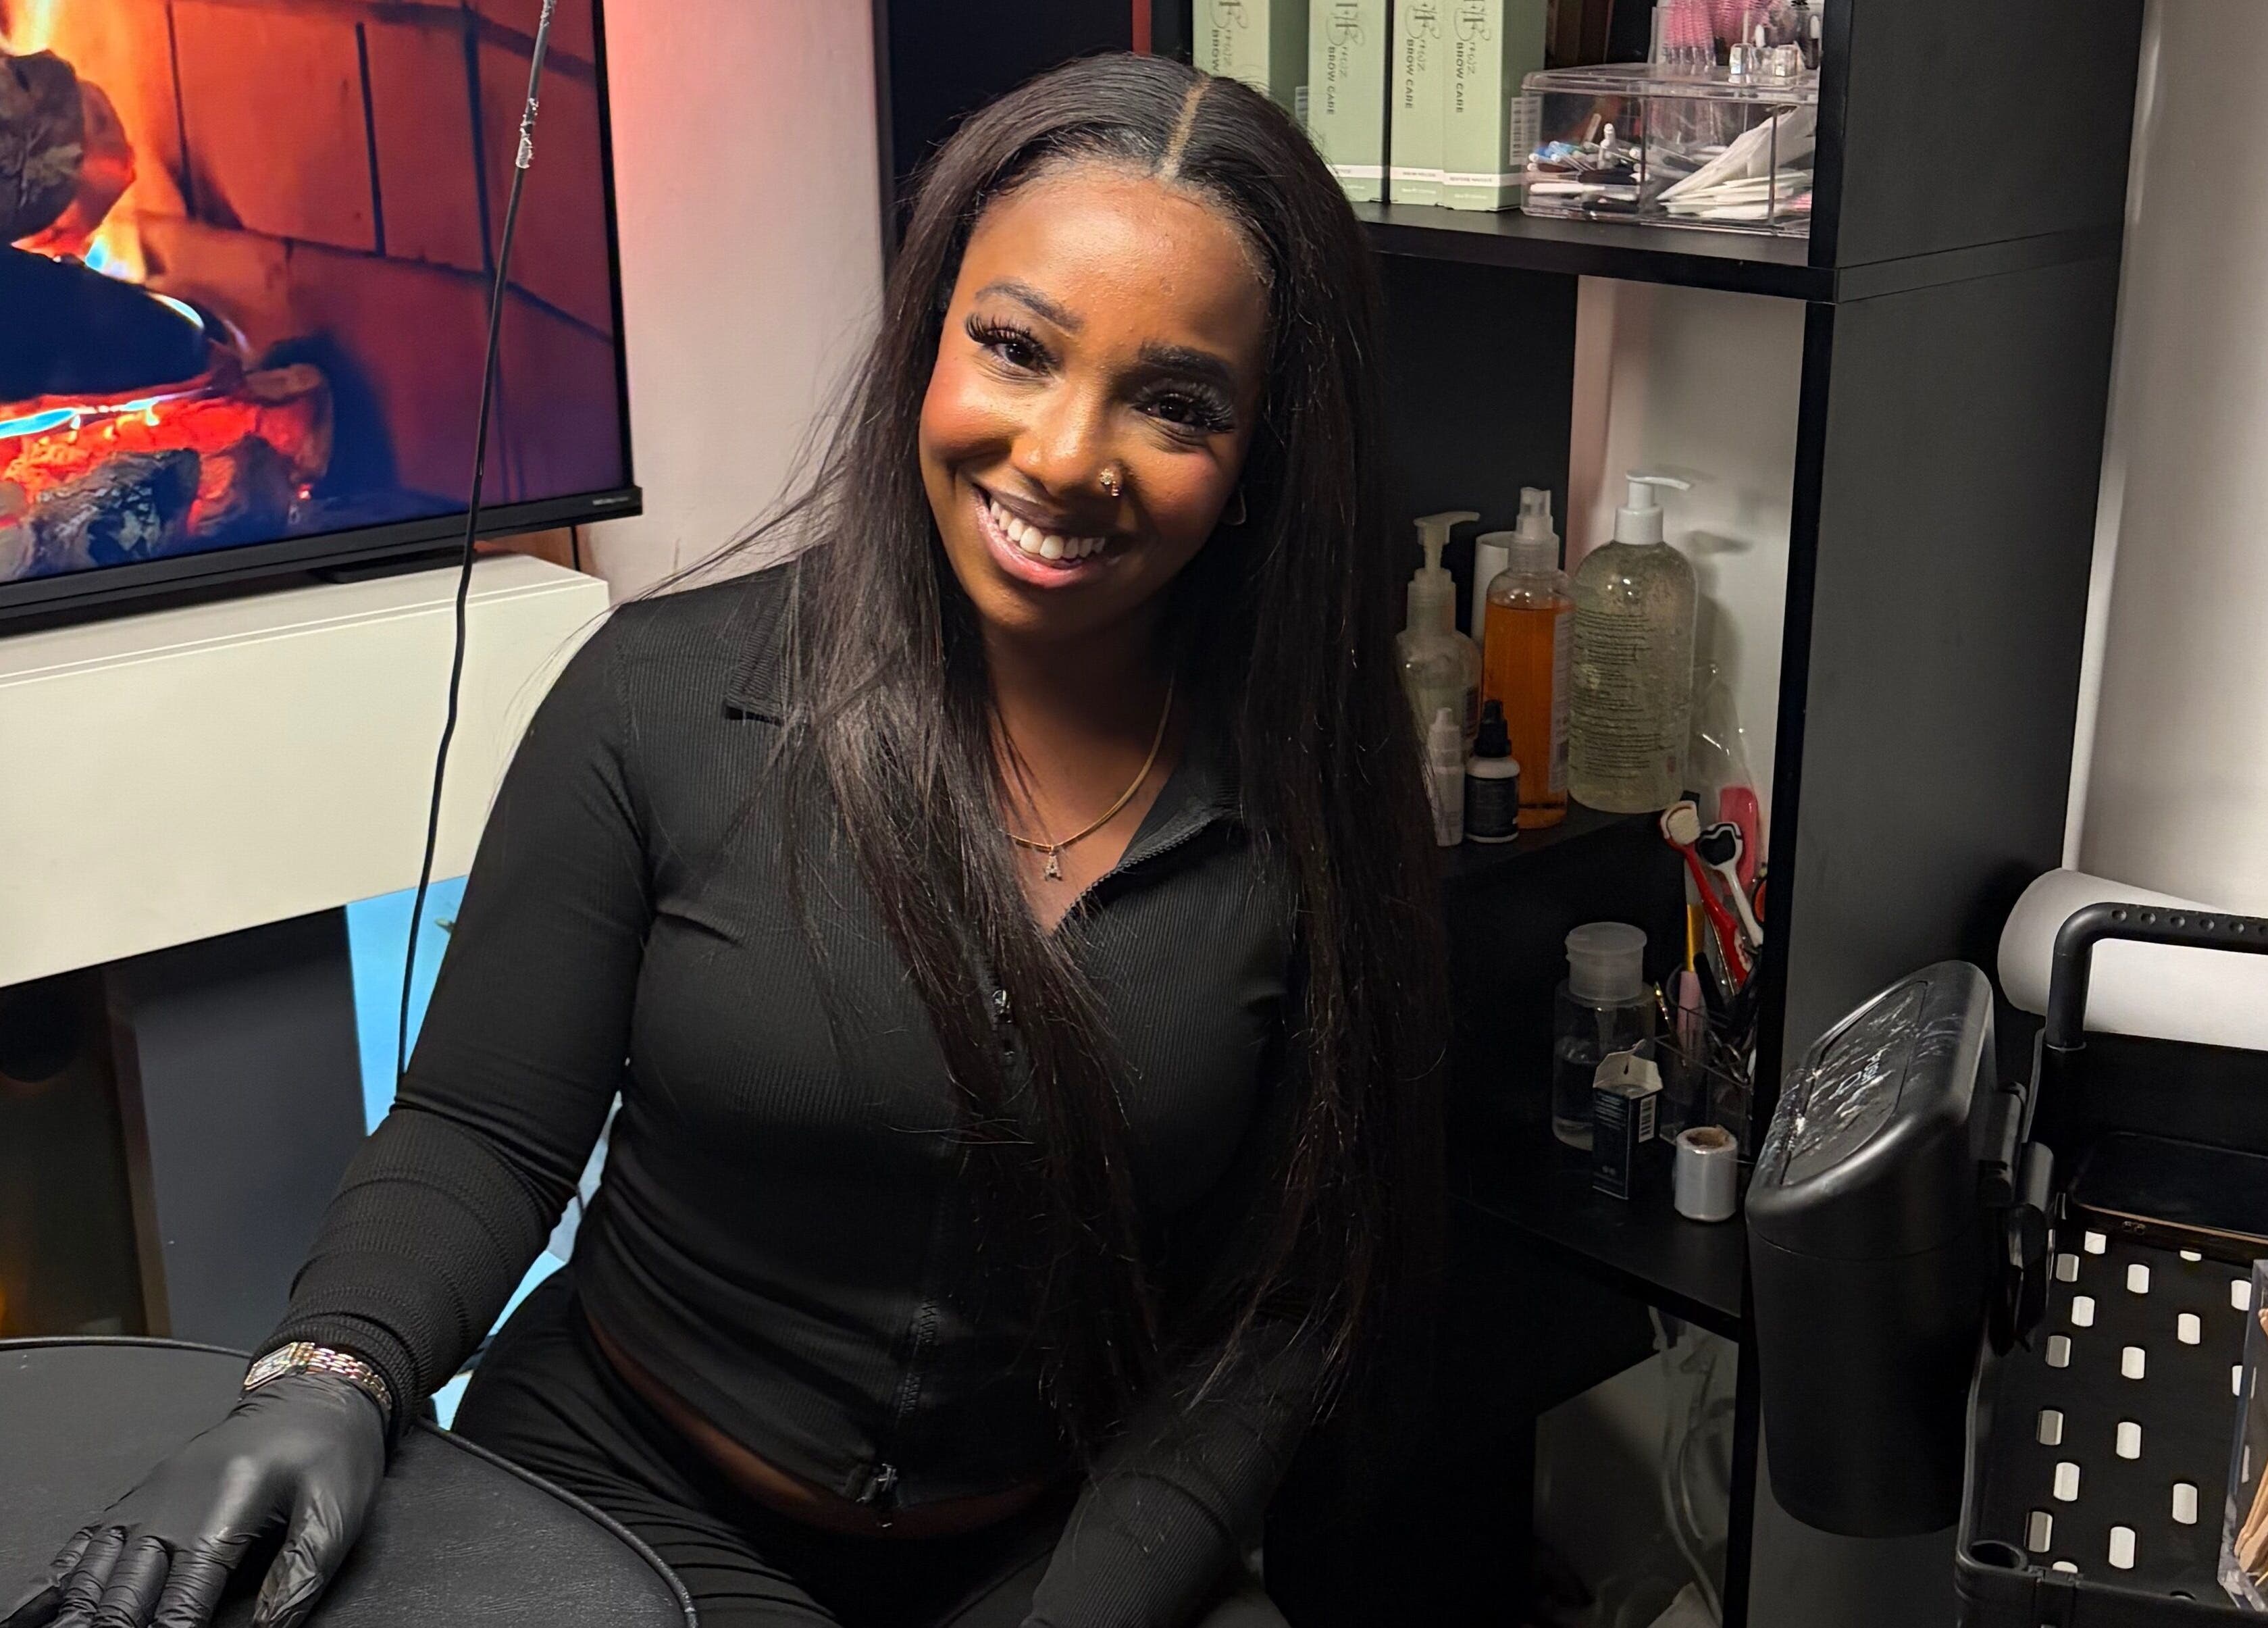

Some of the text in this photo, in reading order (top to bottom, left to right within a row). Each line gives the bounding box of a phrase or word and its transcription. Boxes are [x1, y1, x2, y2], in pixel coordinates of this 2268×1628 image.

[1211, 29, 1220, 72] BROW
[1325, 46, 1336, 115] BROW CARE
[1404, 39, 1415, 109] BROW CARE
[1455, 42, 1465, 113] BROW CARE
